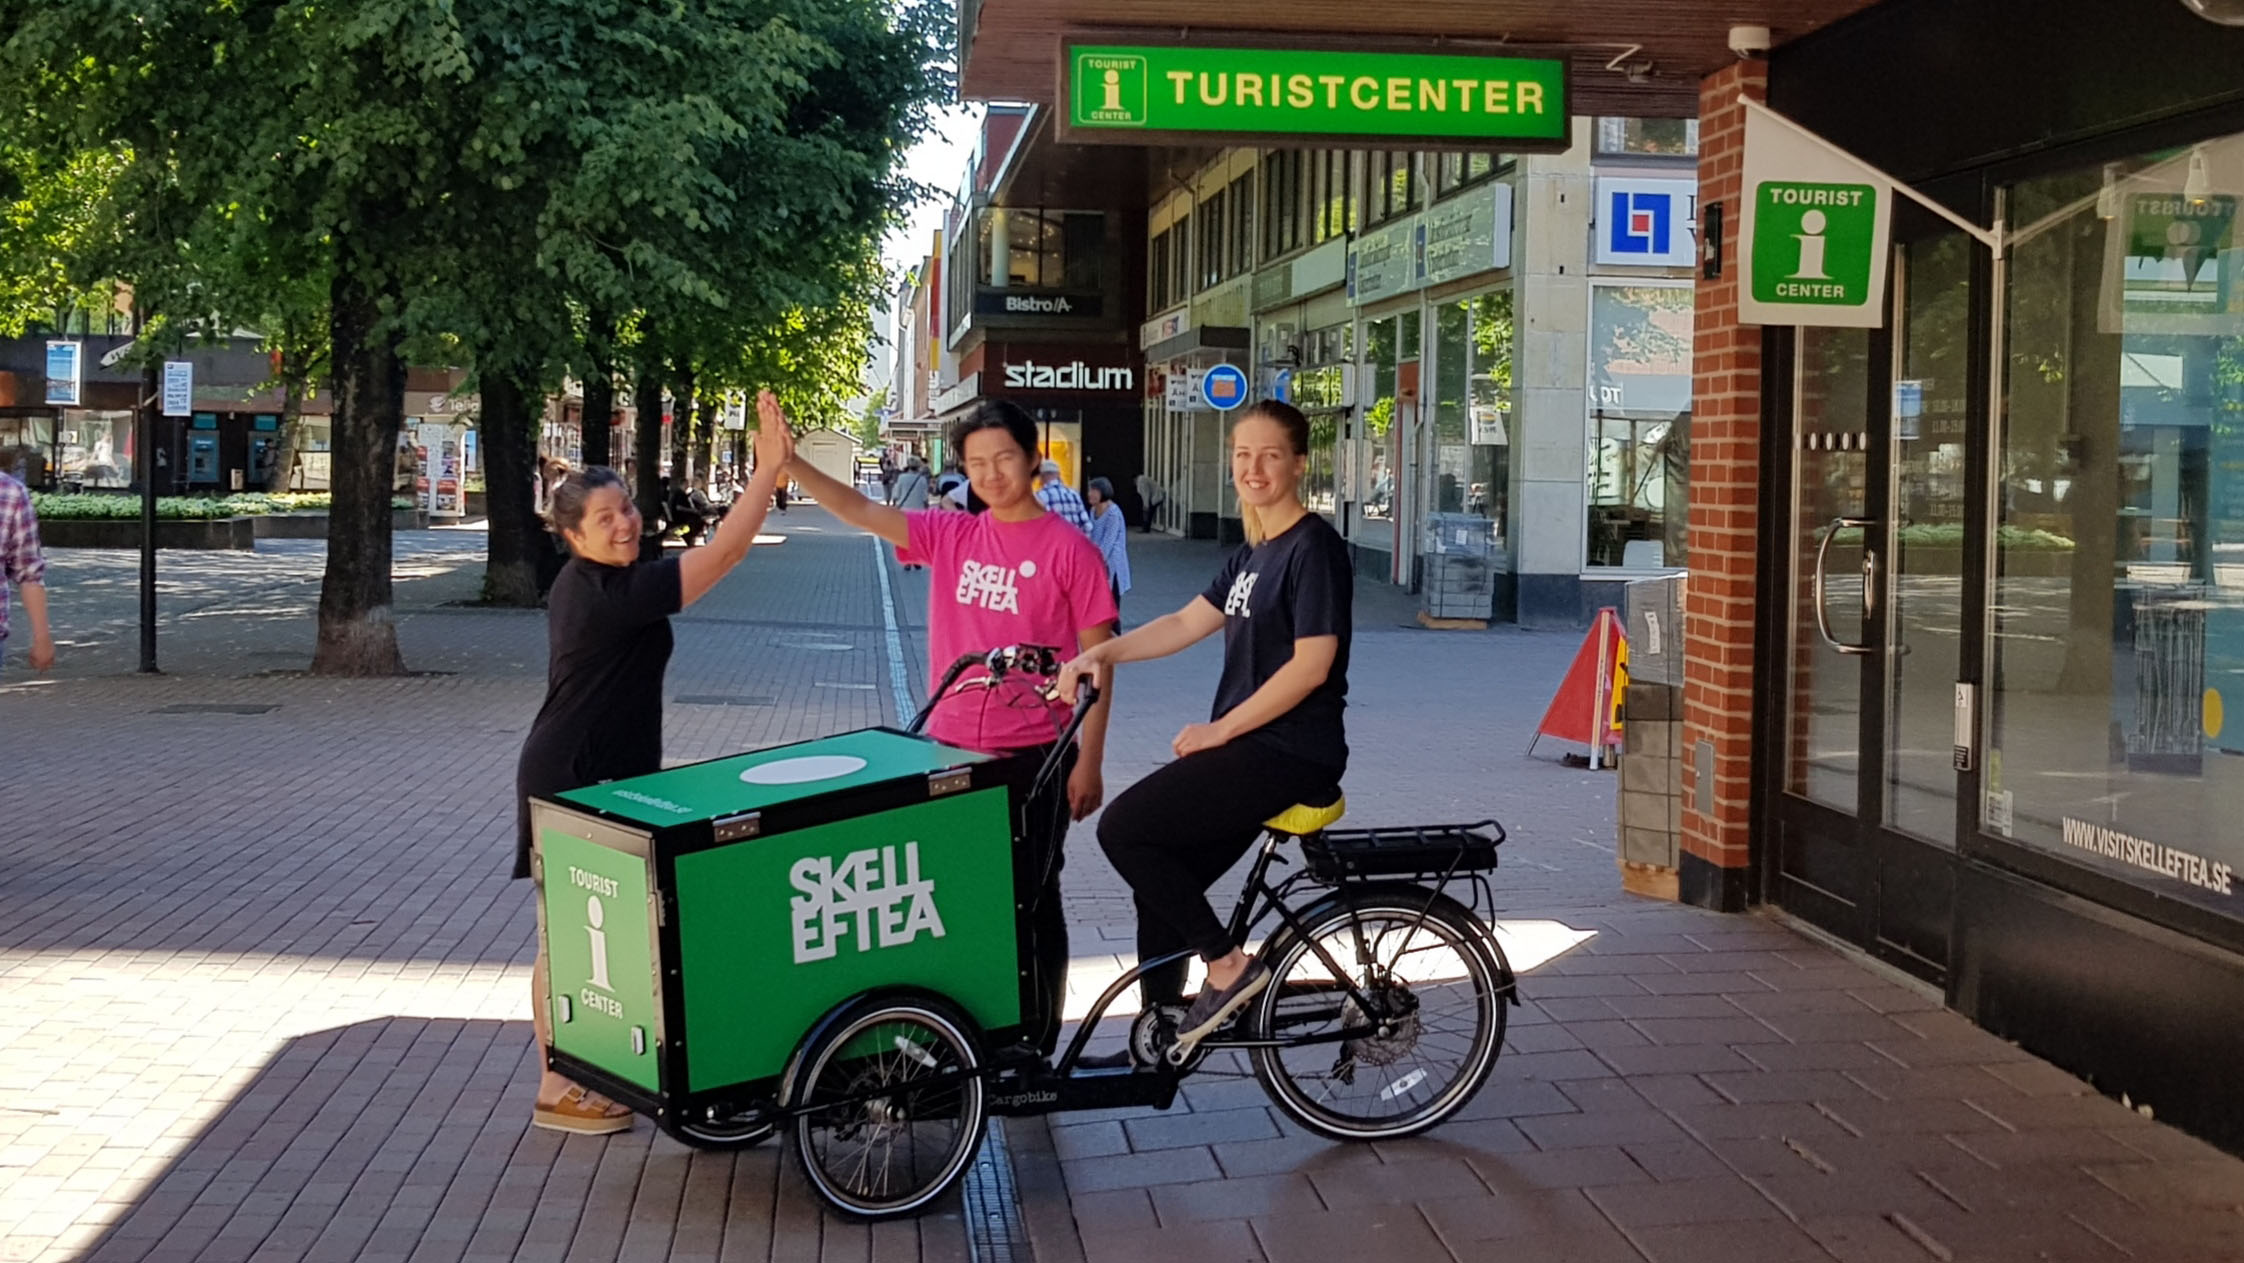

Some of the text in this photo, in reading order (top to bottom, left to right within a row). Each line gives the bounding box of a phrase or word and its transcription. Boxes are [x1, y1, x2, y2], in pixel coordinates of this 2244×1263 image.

[1088, 58, 1137, 70] TOURIST
[1166, 70, 1544, 115] TURISTCENTER
[1091, 111, 1132, 121] CENTER
[1769, 187, 1864, 207] TOURIST
[1775, 282, 1845, 299] CENTER
[1003, 360, 1133, 390] stadium
[960, 559, 1019, 595] SKELL
[956, 580, 1019, 616] EFTEA
[2062, 816, 2232, 896] WWW.VISITSKELLEFTEA.SE
[568, 866, 619, 899] TOURIST
[789, 841, 935, 912] SKELL
[791, 885, 947, 965] EFTEA
[580, 987, 624, 1020] CENTER
